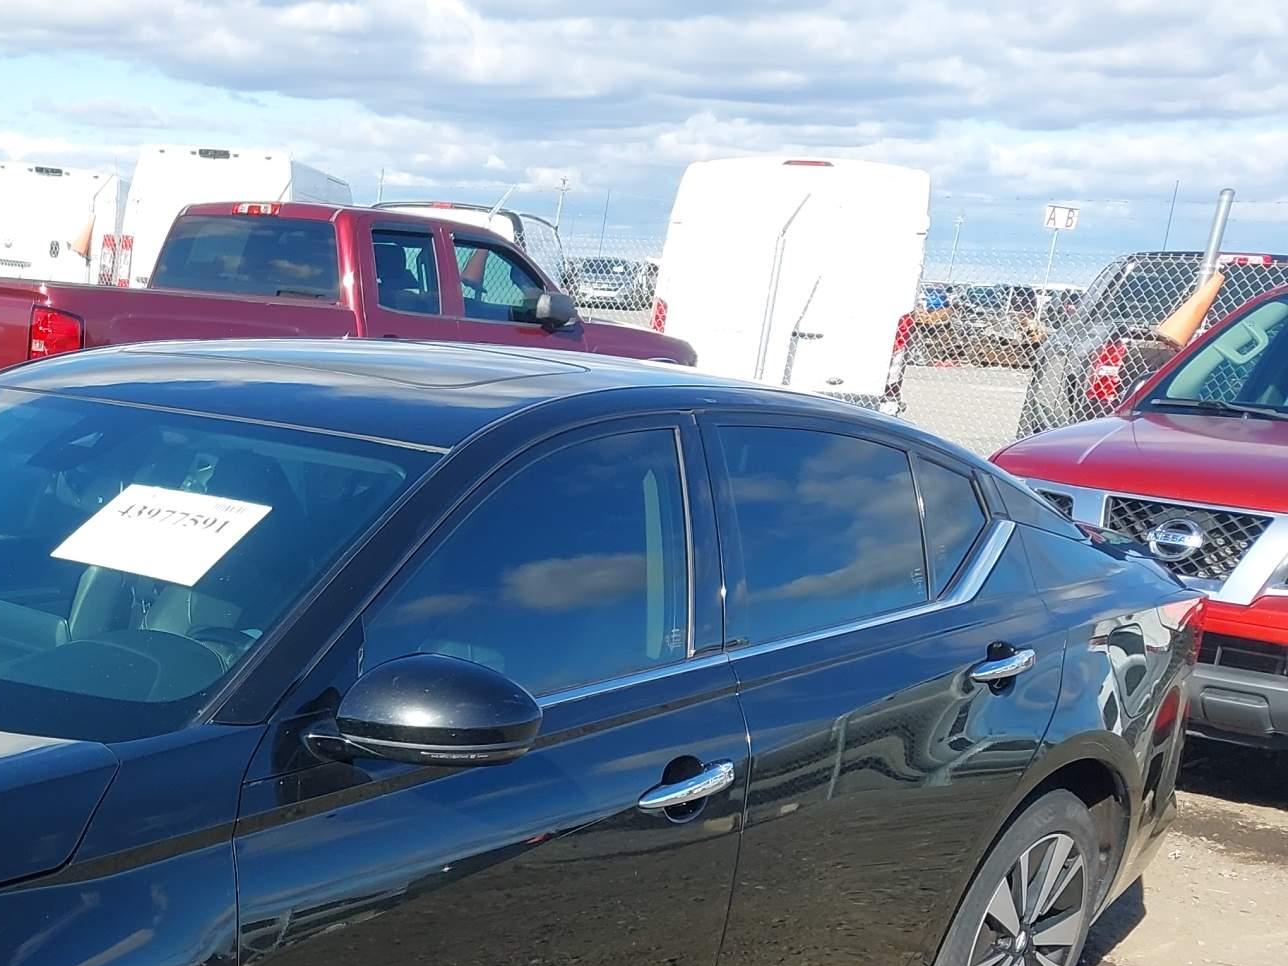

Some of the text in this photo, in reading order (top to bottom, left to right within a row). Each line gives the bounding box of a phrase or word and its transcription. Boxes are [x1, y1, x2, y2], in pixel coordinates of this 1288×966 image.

[1046, 207, 1075, 228] A B
[116, 503, 231, 534] 43977591
